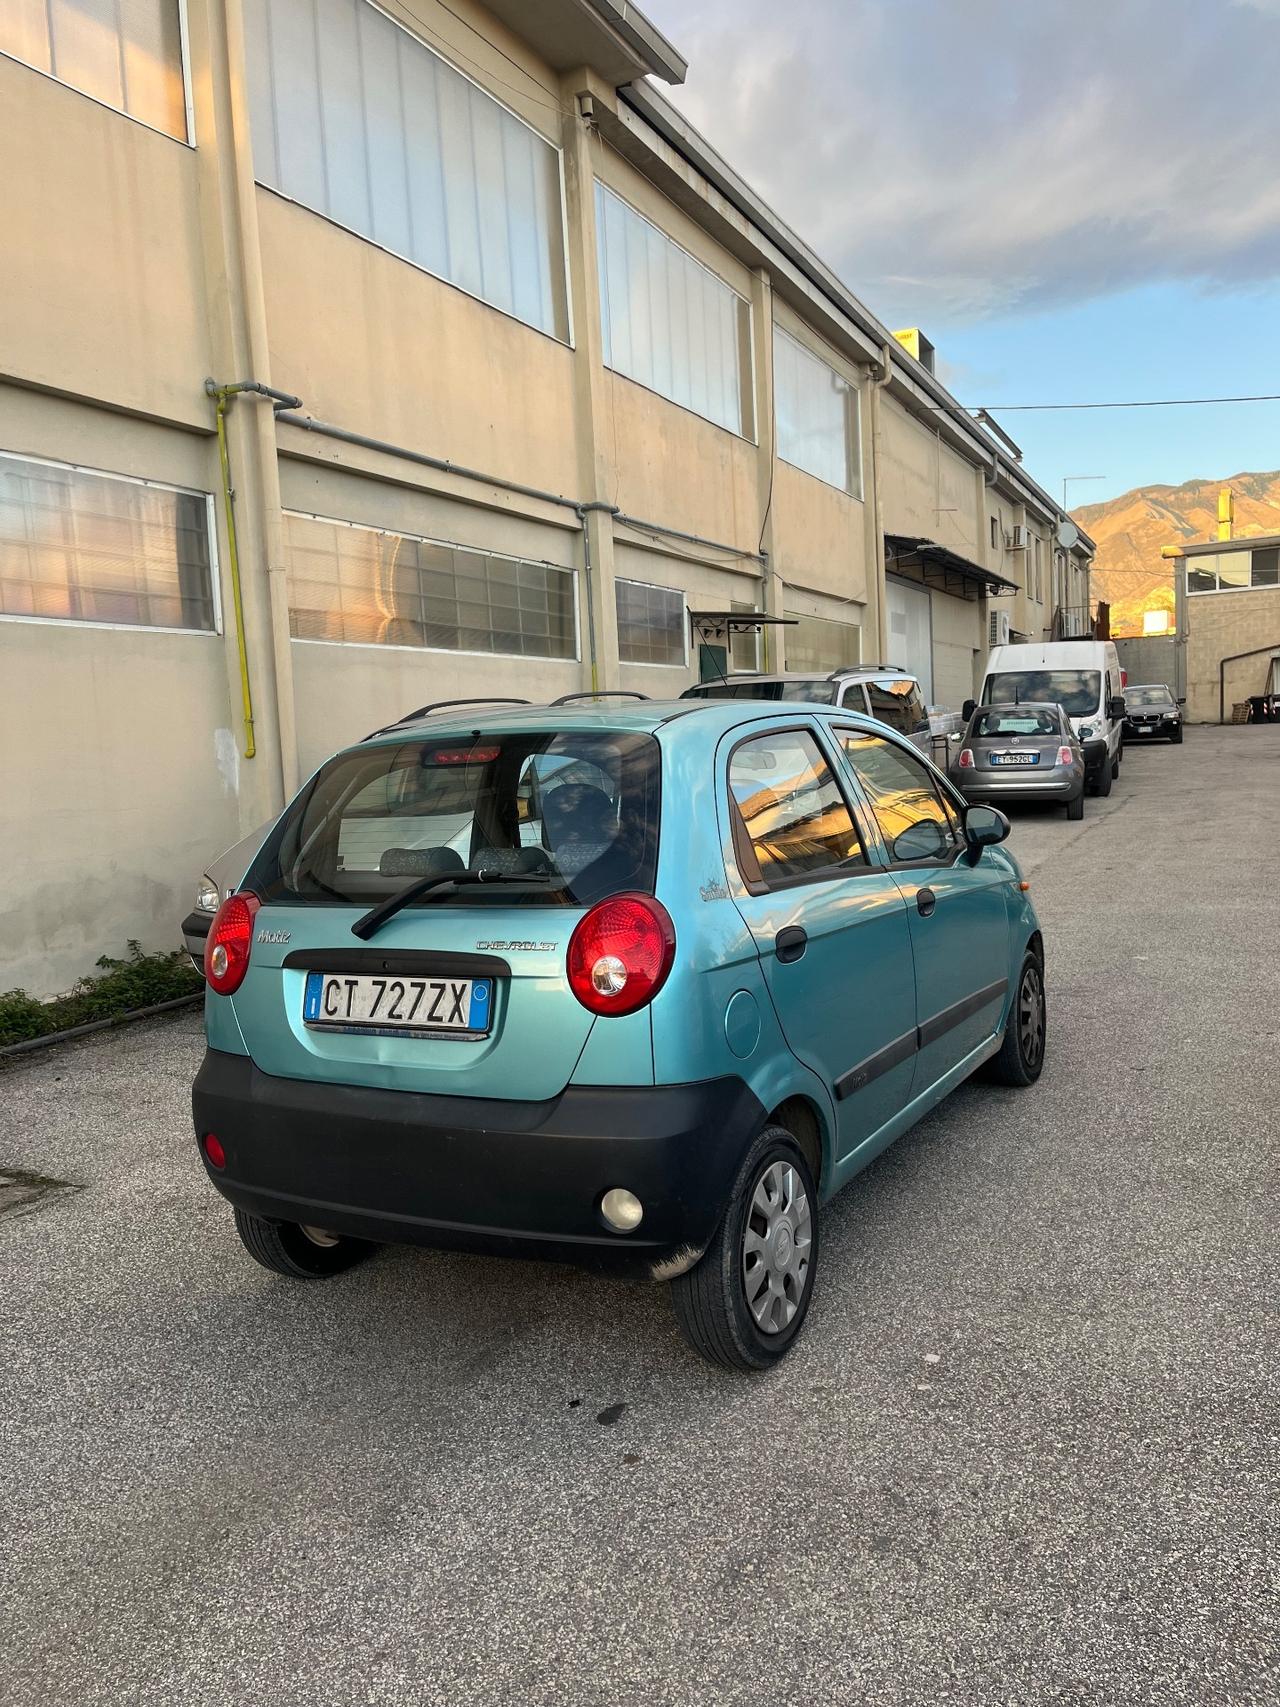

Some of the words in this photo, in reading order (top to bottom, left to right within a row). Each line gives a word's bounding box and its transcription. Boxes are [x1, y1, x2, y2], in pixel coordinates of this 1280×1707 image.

[476, 941, 559, 951] CHEVROLET
[325, 979, 358, 1018] CT
[368, 980, 468, 1023] 727ZX
